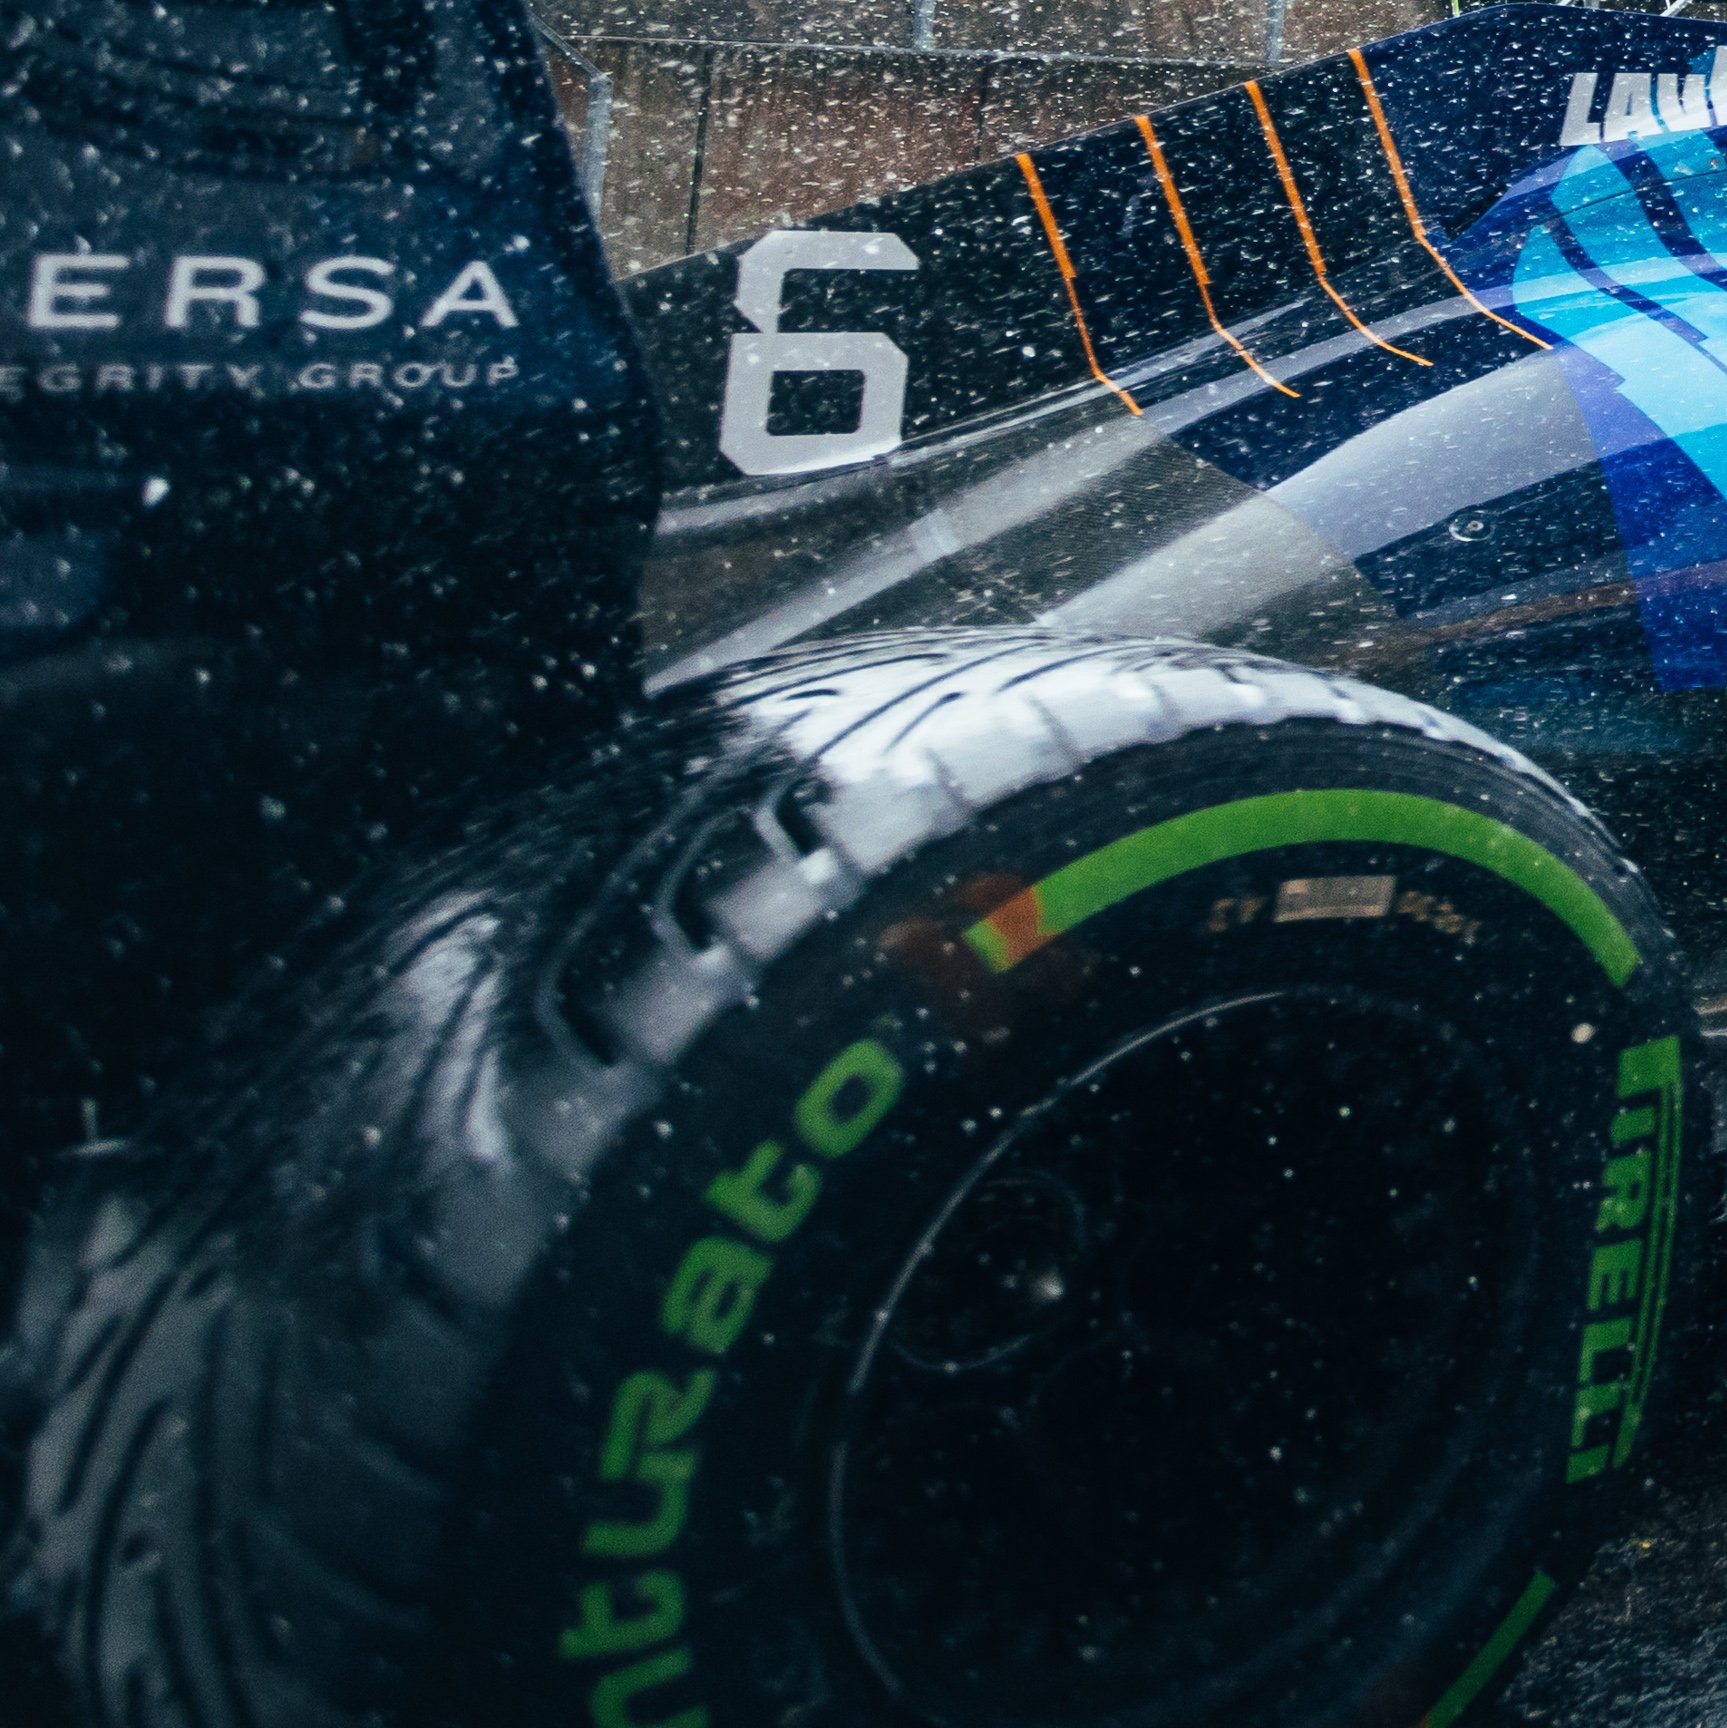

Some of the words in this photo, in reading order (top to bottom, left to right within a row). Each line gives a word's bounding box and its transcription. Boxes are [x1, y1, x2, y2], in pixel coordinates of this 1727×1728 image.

[28, 254, 520, 329] ERSA
[719, 230, 920, 476] 6
[300, 360, 520, 389] GROUP
[1566, 1036, 1681, 1485] PIRELLI
